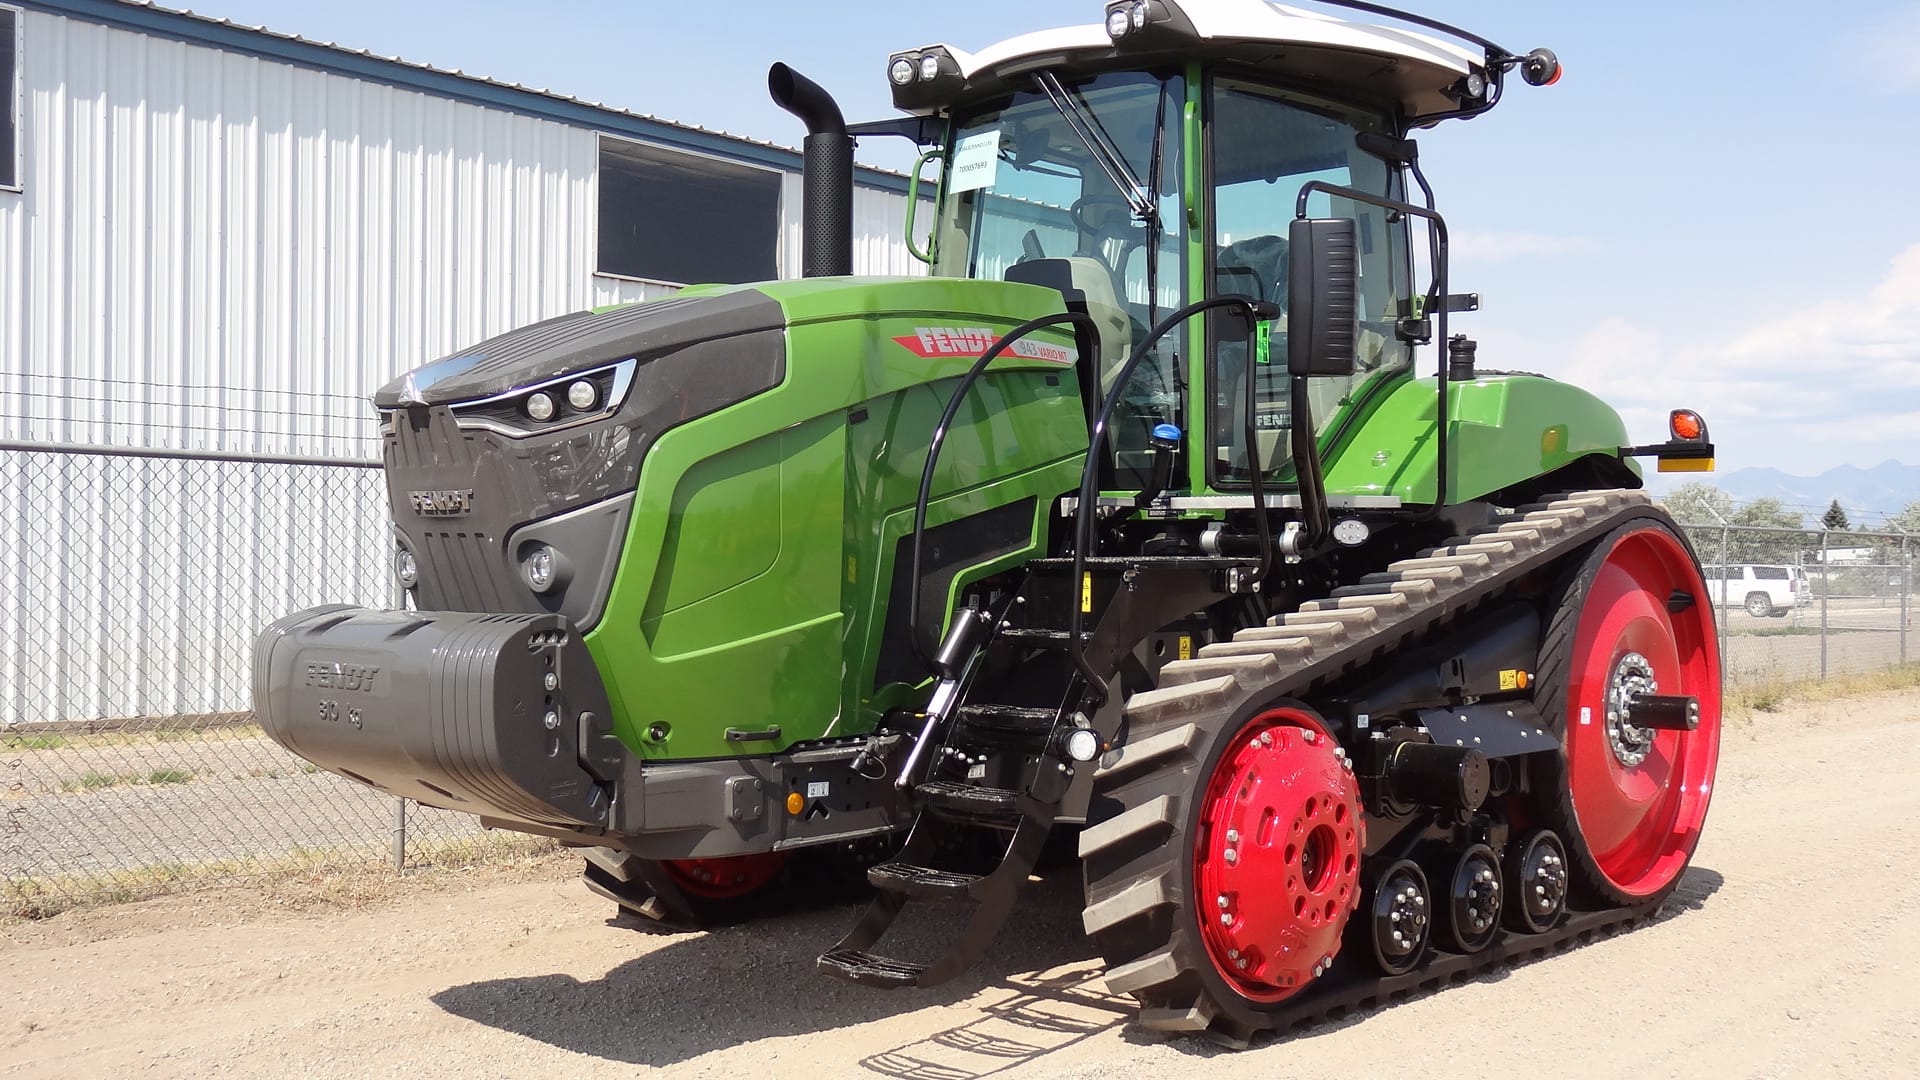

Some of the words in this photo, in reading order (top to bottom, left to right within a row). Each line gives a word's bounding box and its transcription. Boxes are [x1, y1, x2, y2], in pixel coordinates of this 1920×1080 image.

[914, 327, 994, 353] FENDT
[1020, 341, 1038, 356] 943
[1037, 346, 1058, 359] VARIO
[1058, 351, 1068, 361] MT
[408, 489, 473, 515] FENDT
[304, 660, 380, 692] FENDT
